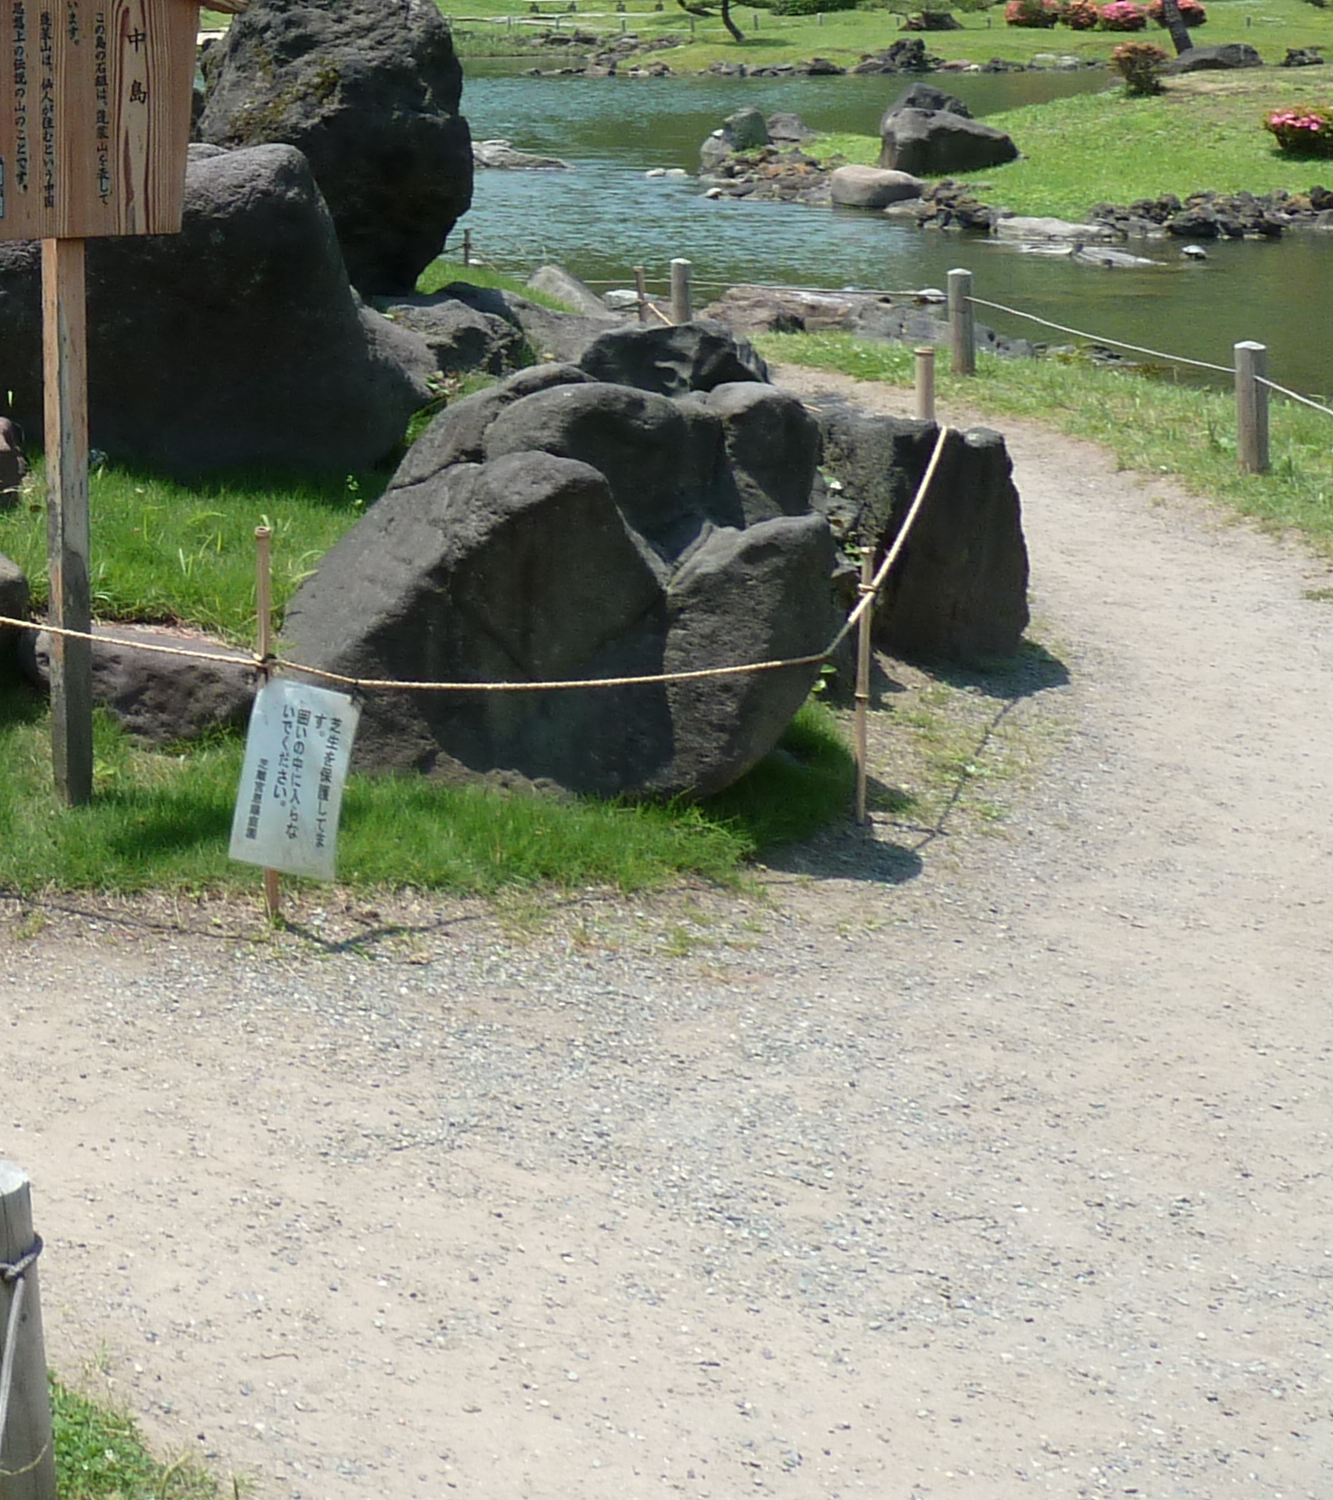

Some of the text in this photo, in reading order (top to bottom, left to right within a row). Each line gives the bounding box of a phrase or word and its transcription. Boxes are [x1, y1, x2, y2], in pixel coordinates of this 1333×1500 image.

[126, 26, 149, 105] 中島
[273, 704, 296, 807] いでください。
[313, 713, 327, 737] す。
[285, 708, 312, 840] 囲いの中に入らな
